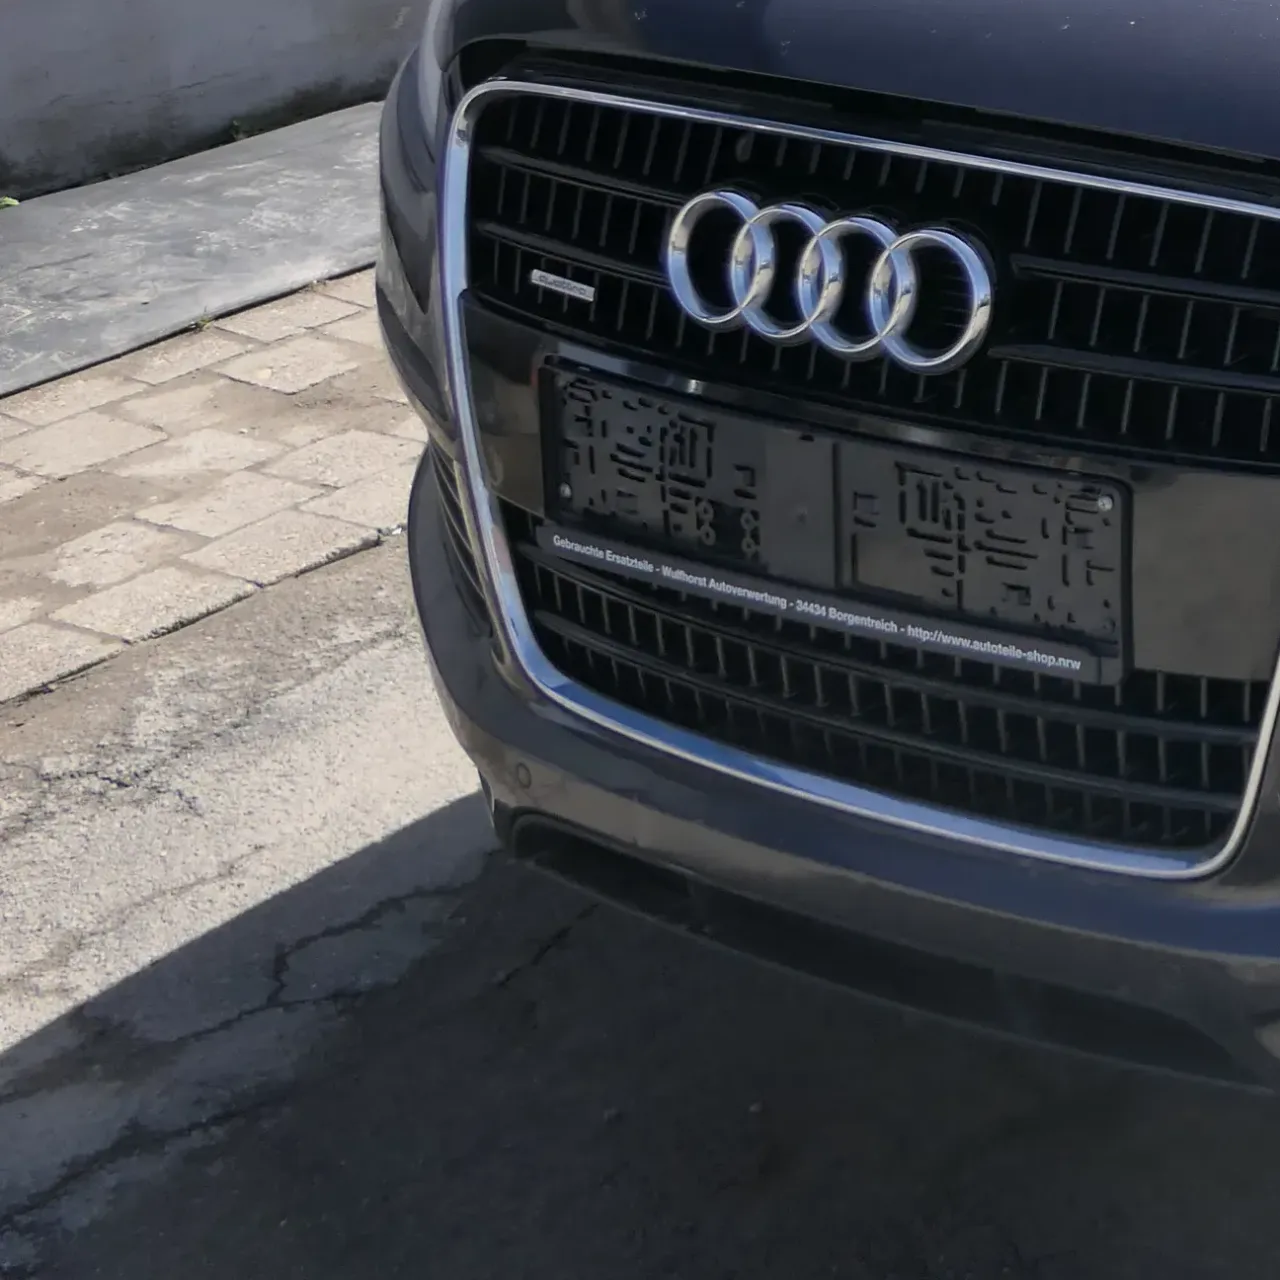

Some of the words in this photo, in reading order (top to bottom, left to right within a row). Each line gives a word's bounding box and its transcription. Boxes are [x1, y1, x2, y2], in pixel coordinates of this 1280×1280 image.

[553, 534, 604, 559] Gebrauchte
[605, 549, 655, 573] Ersatzteile
[662, 565, 707, 588] Wulfhorst
[708, 578, 788, 610] Autoverwertung
[796, 599, 827, 617] 34434
[828, 607, 898, 633] Borgentreich
[907, 625, 1082, 671] http://www.autoteile-shop.nrw
